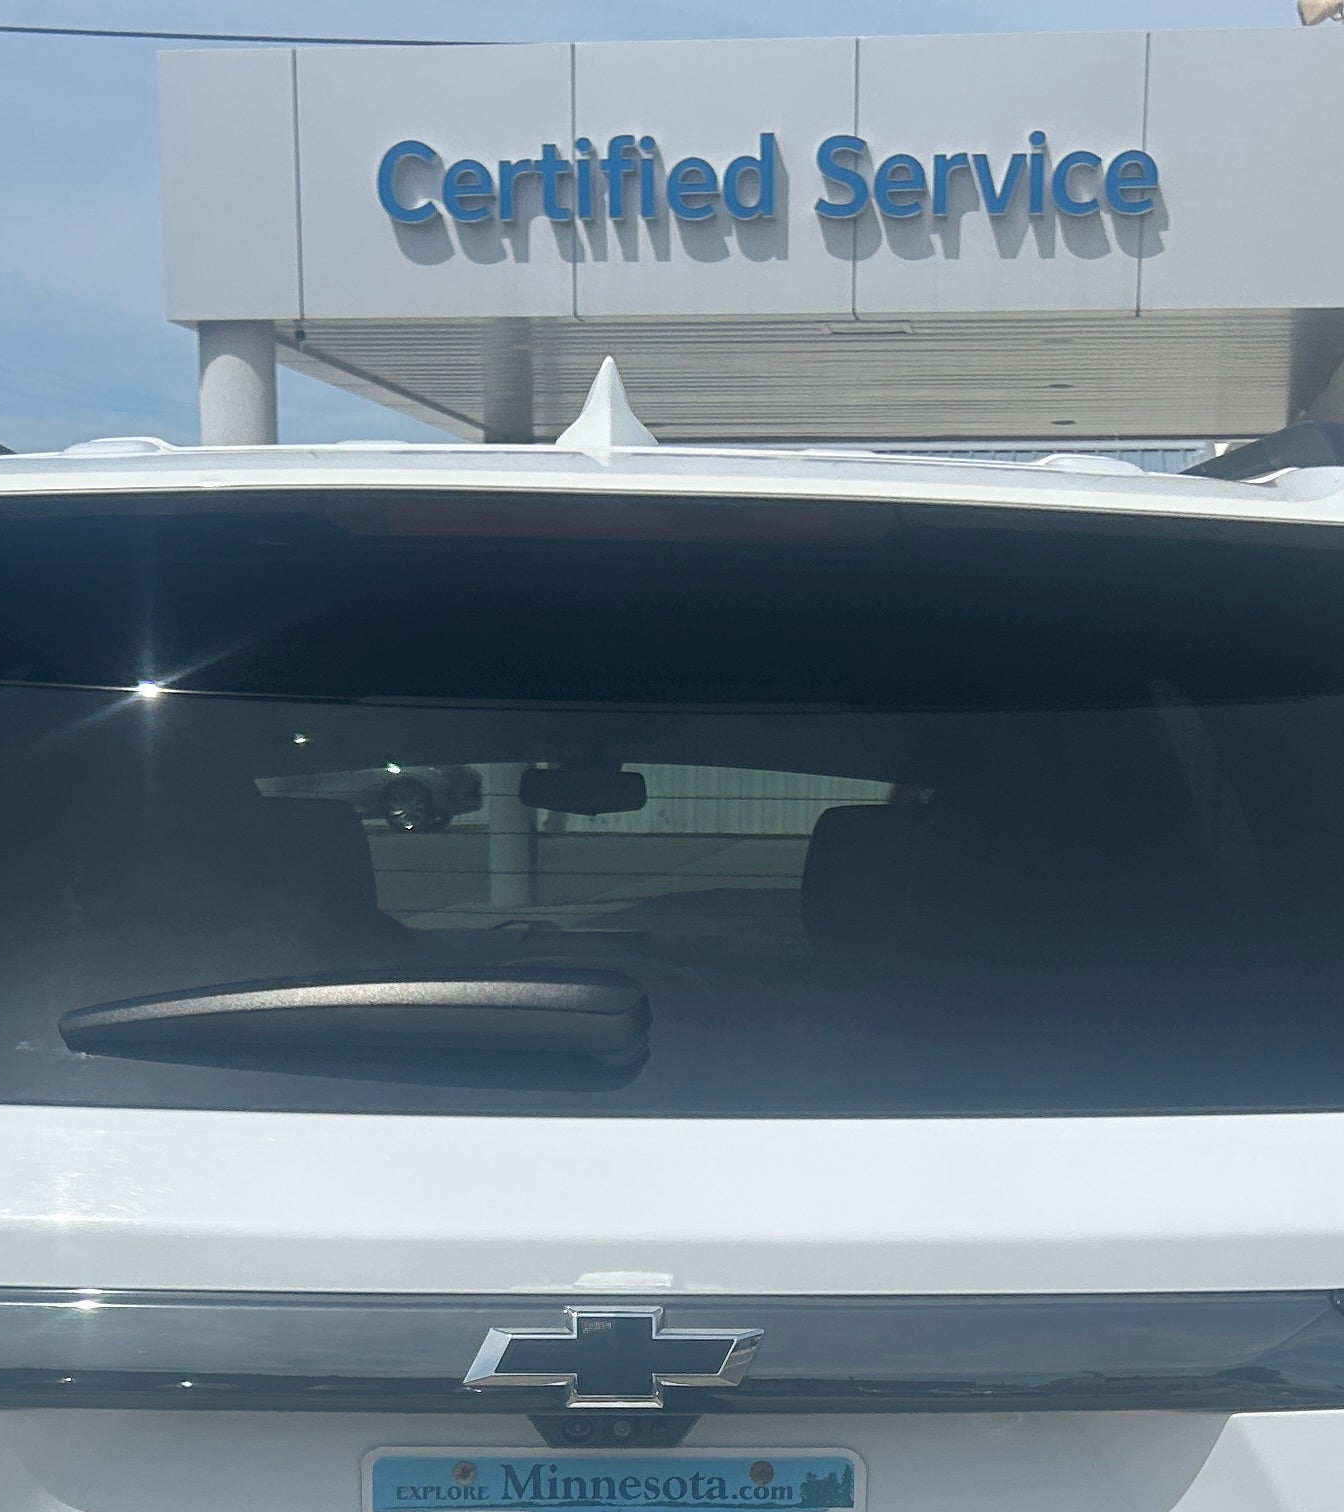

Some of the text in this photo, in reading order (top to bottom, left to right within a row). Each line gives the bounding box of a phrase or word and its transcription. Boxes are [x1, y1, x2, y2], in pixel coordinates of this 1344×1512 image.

[377, 130, 1161, 224] Certified Service
[395, 1463, 794, 1502] EXPLORE Minnesota.com
